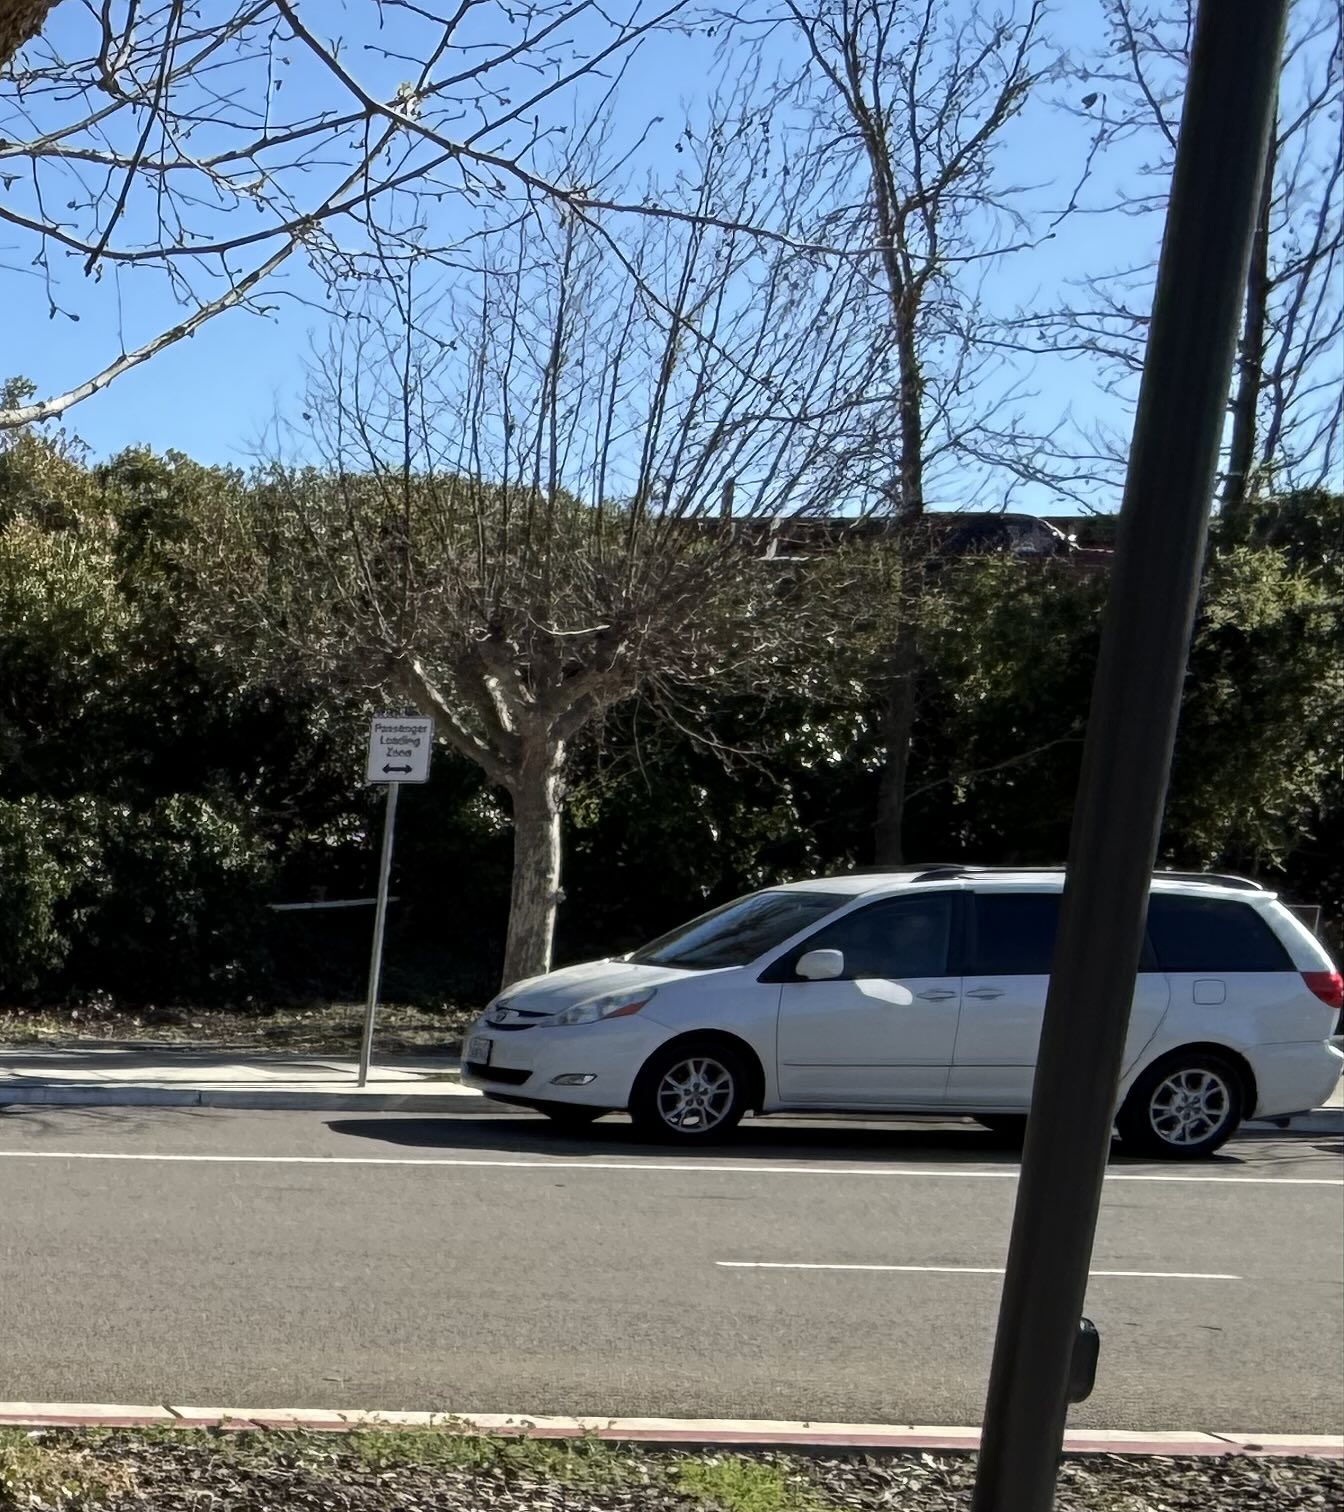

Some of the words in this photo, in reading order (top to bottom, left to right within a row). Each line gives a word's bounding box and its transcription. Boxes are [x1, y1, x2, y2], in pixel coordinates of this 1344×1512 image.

[374, 723, 428, 735] Passenger
[380, 735, 421, 748] Loading
[386, 747, 412, 757] Zone
